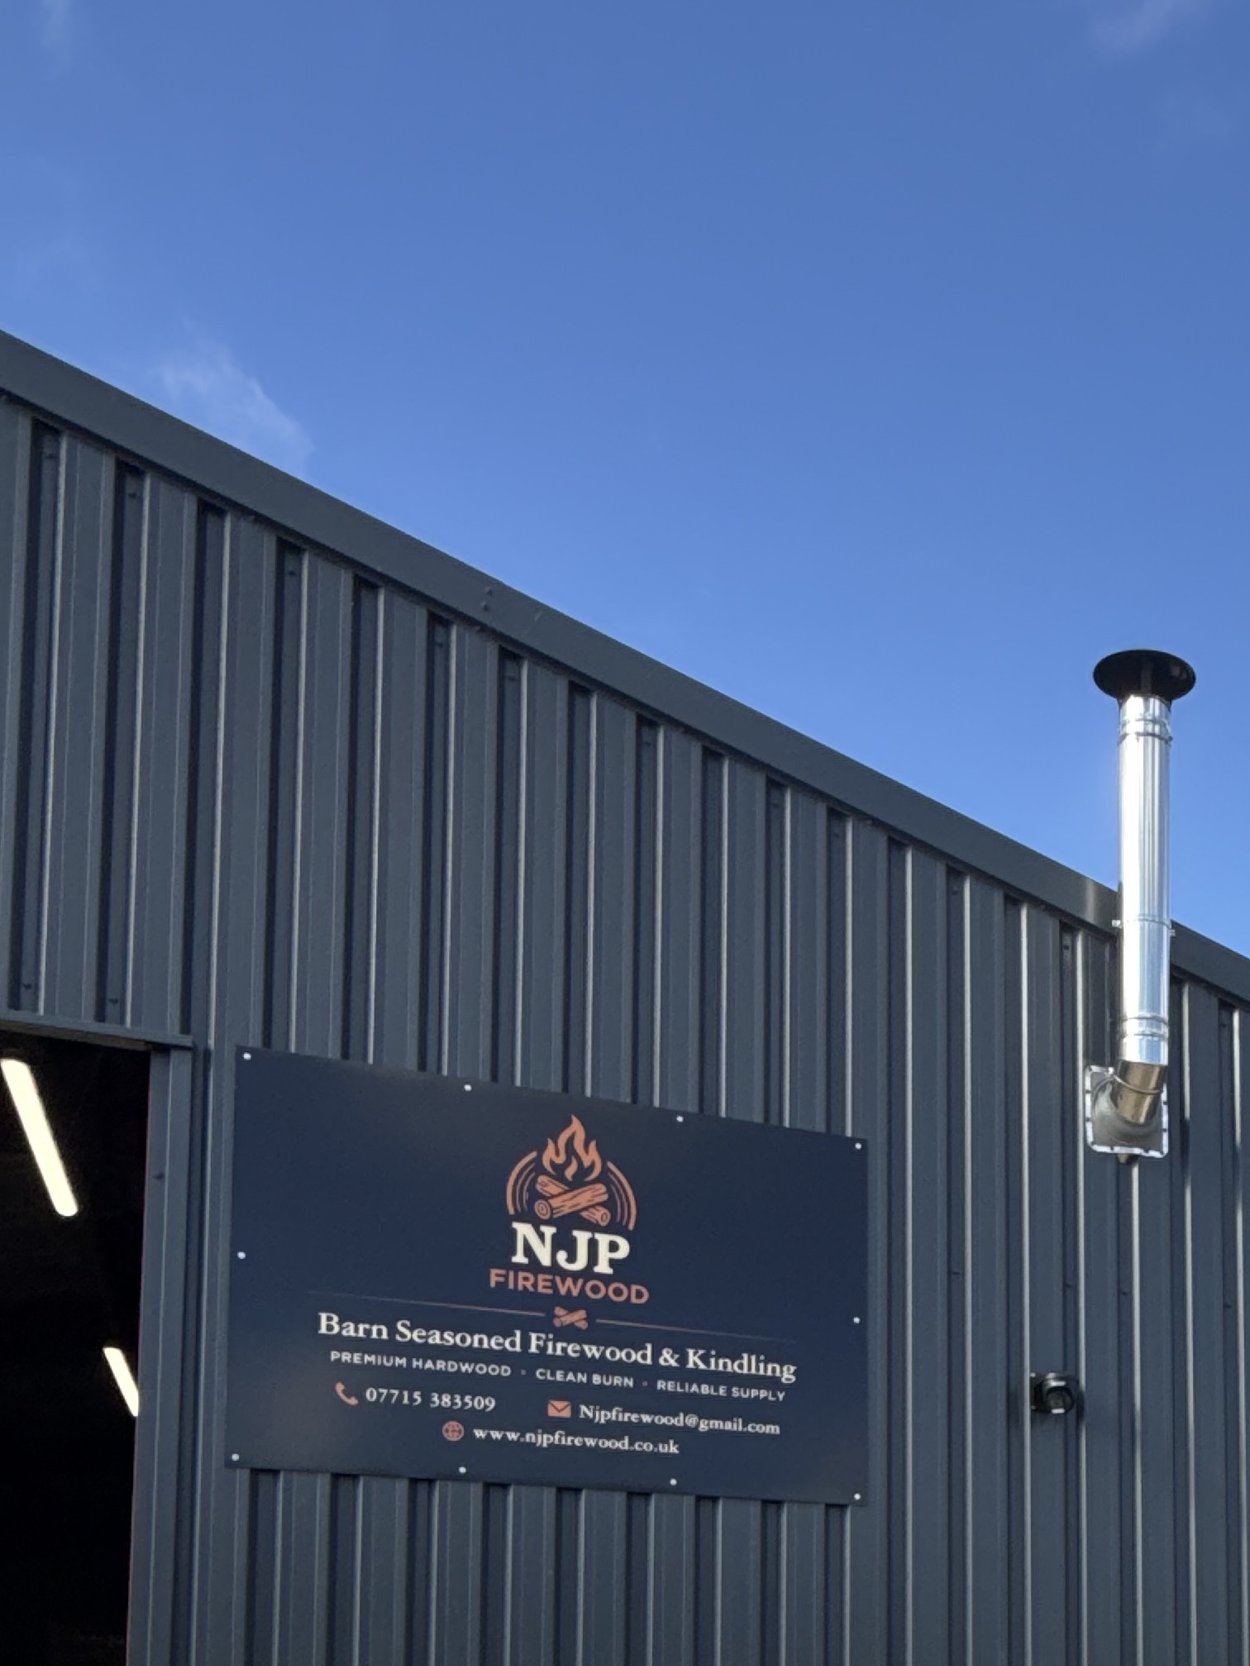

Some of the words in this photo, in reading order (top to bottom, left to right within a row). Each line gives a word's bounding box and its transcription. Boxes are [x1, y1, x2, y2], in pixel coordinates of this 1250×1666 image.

[511, 1221, 630, 1275] NJP
[489, 1268, 650, 1304] FIREWOOD
[318, 1312, 389, 1340] Barn
[396, 1320, 522, 1352] Seasoned
[528, 1332, 653, 1365] Firewood
[659, 1348, 680, 1367] &
[686, 1348, 797, 1384] Kindling
[330, 1351, 407, 1368] PREMIUM
[412, 1358, 512, 1377] HARDWOOD
[535, 1368, 587, 1384] CLEAN
[592, 1374, 634, 1388] BURN
[657, 1380, 727, 1397] RELIABLE
[731, 1386, 786, 1402] SUPPLY
[366, 1387, 422, 1406] 07715
[430, 1393, 496, 1412] 383509
[579, 1404, 781, 1435] Njpfirewood@gmail.com
[473, 1428, 680, 1454] www.njpfirewood.co.uk
